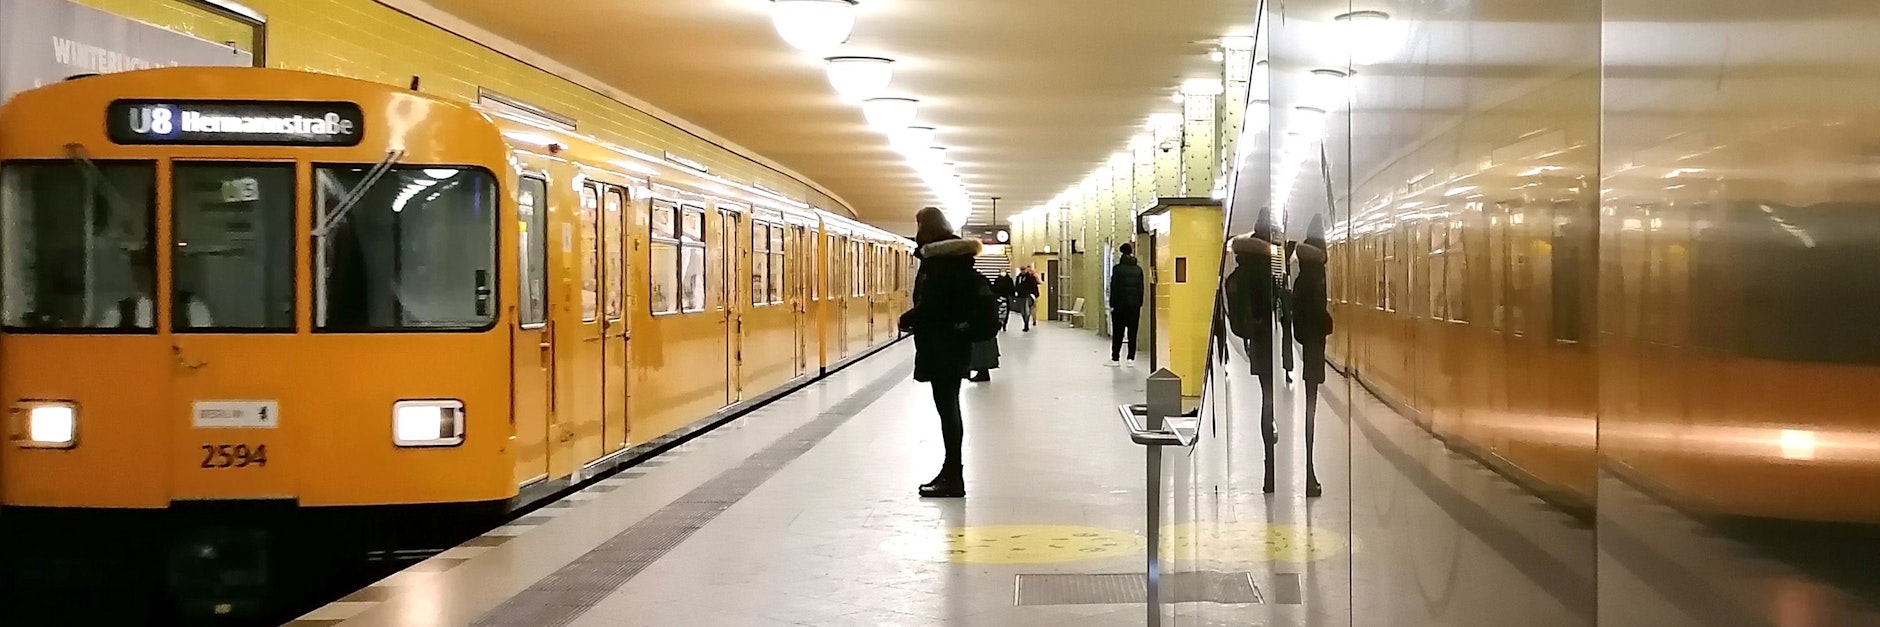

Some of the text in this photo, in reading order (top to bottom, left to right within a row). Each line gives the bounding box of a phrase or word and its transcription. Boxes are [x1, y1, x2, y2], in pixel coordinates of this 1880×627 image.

[129, 107, 354, 135] U8 Hermannstraße
[201, 443, 267, 469] 2594
